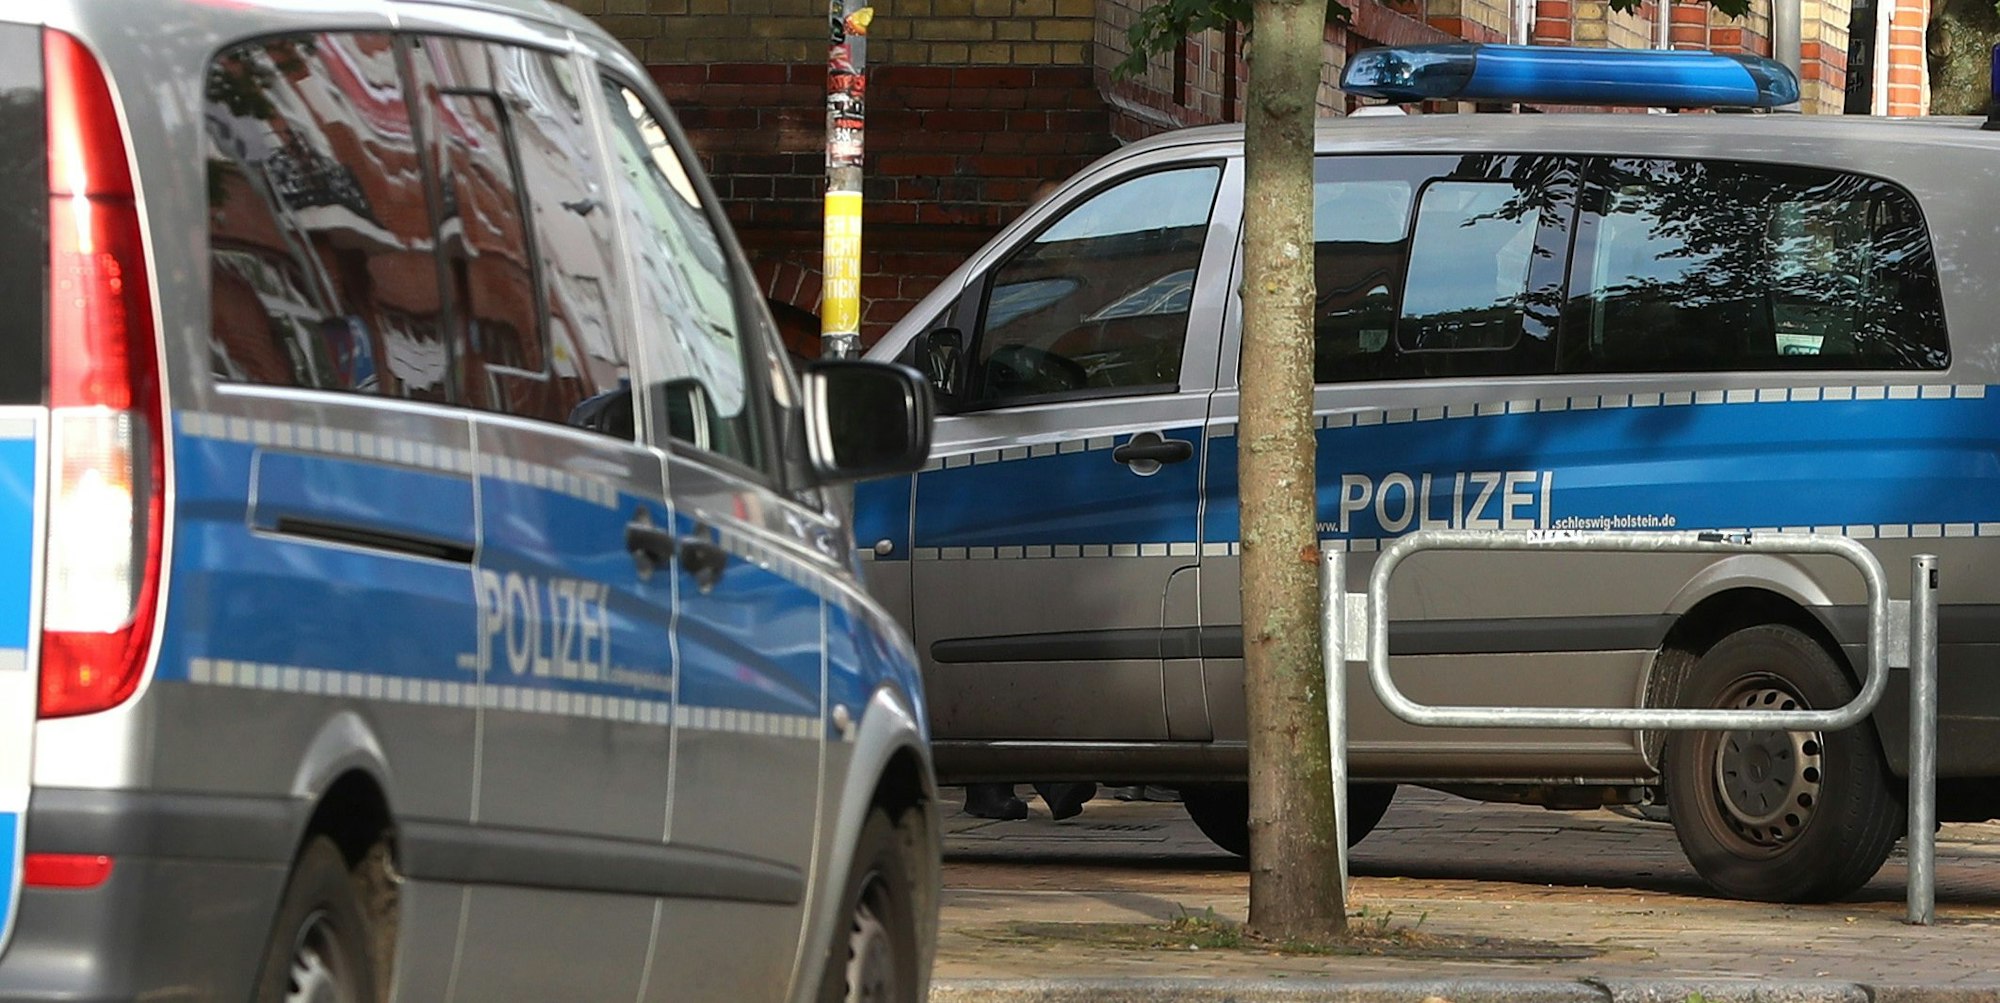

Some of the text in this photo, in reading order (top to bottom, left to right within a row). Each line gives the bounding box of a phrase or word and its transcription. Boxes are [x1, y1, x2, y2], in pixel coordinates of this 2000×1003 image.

[824, 237, 859, 256] ICHT
[823, 258, 858, 278] UF'N
[1340, 471, 1553, 533] POLIZEI
[1551, 513, 1676, 530] .schleswig-holstein.de
[478, 568, 611, 682] POLIZEI
